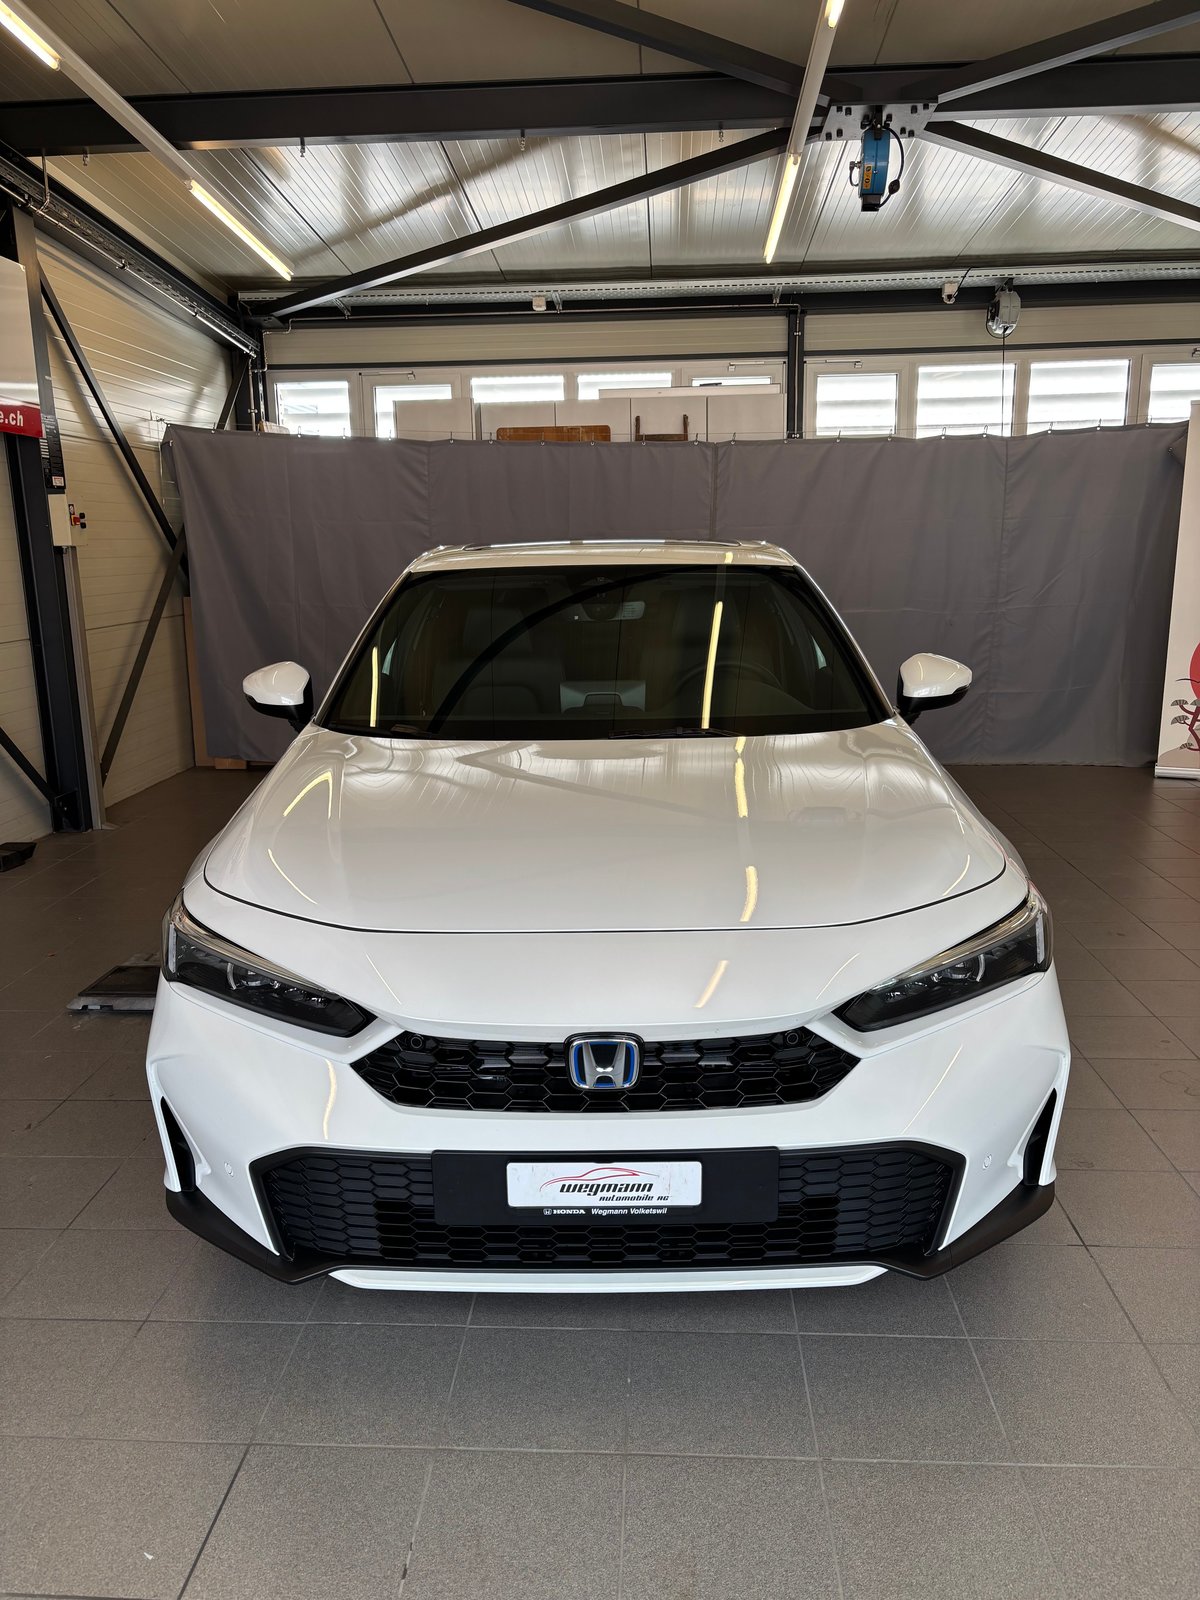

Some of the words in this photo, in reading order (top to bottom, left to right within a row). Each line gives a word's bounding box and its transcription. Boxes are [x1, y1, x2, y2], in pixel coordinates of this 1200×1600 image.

[560, 1183, 653, 1196] wegmann
[599, 1194, 654, 1202] automobile
[591, 1208, 628, 1216] Wegmann
[630, 1207, 668, 1215] Volketswil
